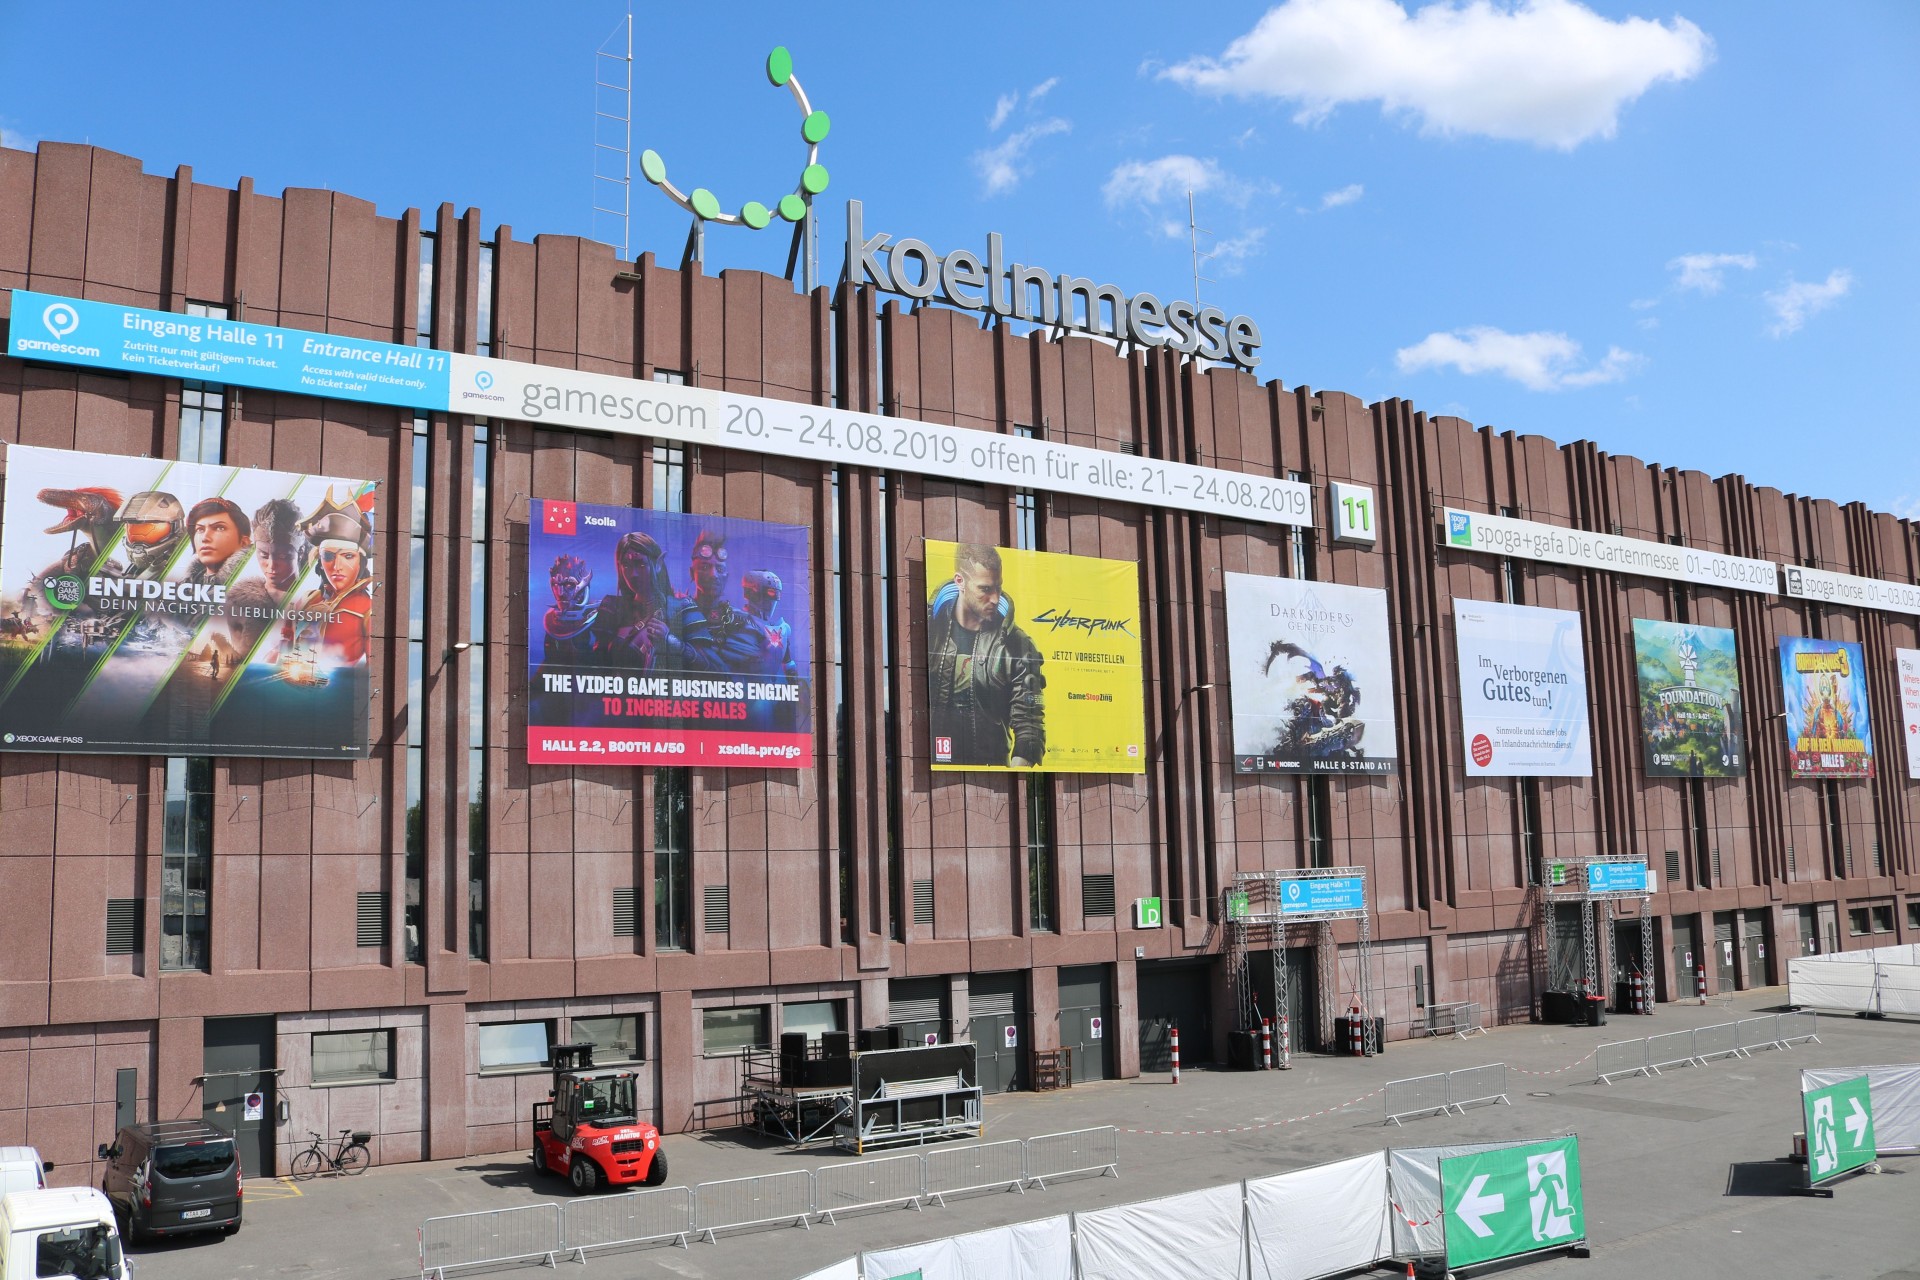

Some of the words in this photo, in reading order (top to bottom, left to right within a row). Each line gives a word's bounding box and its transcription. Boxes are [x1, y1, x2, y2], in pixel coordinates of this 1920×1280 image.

[846, 198, 1262, 368] koelnmesse
[123, 313, 201, 342] Eingang
[207, 325, 257, 346] Halle
[264, 332, 284, 350] 11
[17, 338, 100, 357] gamescom
[123, 340, 158, 353] Zutritt
[160, 346, 177, 356] nur
[180, 348, 198, 358] mit
[200, 350, 244, 365] gültigem
[246, 356, 279, 369] Ticket.
[302, 338, 382, 363] Entrance
[385, 350, 422, 369] Hall
[426, 356, 445, 372] 11
[121, 352, 145, 363] Kein
[147, 355, 220, 373] Ticketverkauf!
[301, 376, 315, 386] No
[316, 378, 343, 389] ticket
[344, 380, 367, 392] sale!
[302, 364, 333, 377] Access
[334, 369, 355, 380] with
[356, 372, 377, 382] valid
[378, 374, 404, 386] ticket
[405, 378, 427, 391] only.
[462, 391, 505, 402] gamescom
[521, 383, 706, 430] gamescom
[970, 441, 1036, 476] offen
[1045, 450, 1079, 482] für
[1087, 458, 1134, 491] alle:
[584, 515, 616, 527] Xsolla
[1343, 496, 1370, 531] 11
[1477, 526, 1563, 558] spoga+gafa
[1568, 535, 1591, 558] Die
[1594, 540, 1679, 572] Gartenmesse
[89, 576, 226, 603] ENTDECKE
[1805, 578, 1835, 600] spoga
[1837, 577, 1864, 600] horse
[57, 593, 79, 601] PASS
[100, 598, 137, 611] DEIN
[145, 599, 225, 616] NÄCHSTES
[231, 606, 343, 624] LIEBLINGSSPIEL
[1287, 621, 1336, 633] GENESIS
[1052, 651, 1073, 661] JETZT
[1075, 652, 1125, 665] VORBESTELLEN
[1837, 648, 1850, 677] 3
[1478, 655, 1492, 668] Im
[1493, 664, 1568, 686] Verborgenen
[1902, 660, 1914, 673] Play
[542, 674, 572, 693] THE
[575, 675, 623, 695] VIDEO
[627, 677, 669, 697] GAME
[672, 679, 743, 699] BUSINESS
[748, 683, 799, 702] ENGINE
[1483, 678, 1531, 703] Gutes
[1904, 686, 1919, 697] When
[1659, 690, 1723, 710] FOUNDATION
[1906, 700, 1918, 709] How
[602, 697, 621, 716] TO
[626, 698, 699, 718] INCREASE
[702, 701, 747, 720] SALES
[1676, 711, 1686, 719] Hall
[39, 735, 61, 743] GAME
[62, 736, 83, 744] PASS
[1495, 726, 1523, 735] Sinnvolle
[1523, 728, 1535, 736] und
[1536, 728, 1555, 736] sichere
[1555, 728, 1567, 738] Jobs
[542, 740, 576, 752] HALL
[579, 740, 605, 755] 2.2,
[608, 741, 651, 753] BOOTH
[654, 742, 685, 754] A/50
[718, 743, 801, 758] xsolla.pro/gc
[937, 739, 950, 753] 18
[1492, 739, 1501, 748] im
[1501, 740, 1572, 749] Inlandsnachrichtendienst
[1797, 737, 1809, 752] AUF
[1810, 738, 1818, 752] IN
[1818, 738, 1832, 752] DEN
[1832, 739, 1865, 753] WAHNSINN
[1314, 761, 1339, 769] HALLE
[1377, 762, 1391, 770] A11
[1820, 753, 1840, 768] HALLE
[1310, 882, 1330, 890] Eingang
[1311, 896, 1332, 904] Entrance
[1148, 909, 1159, 923] D
[614, 1132, 640, 1140] MANITOU
